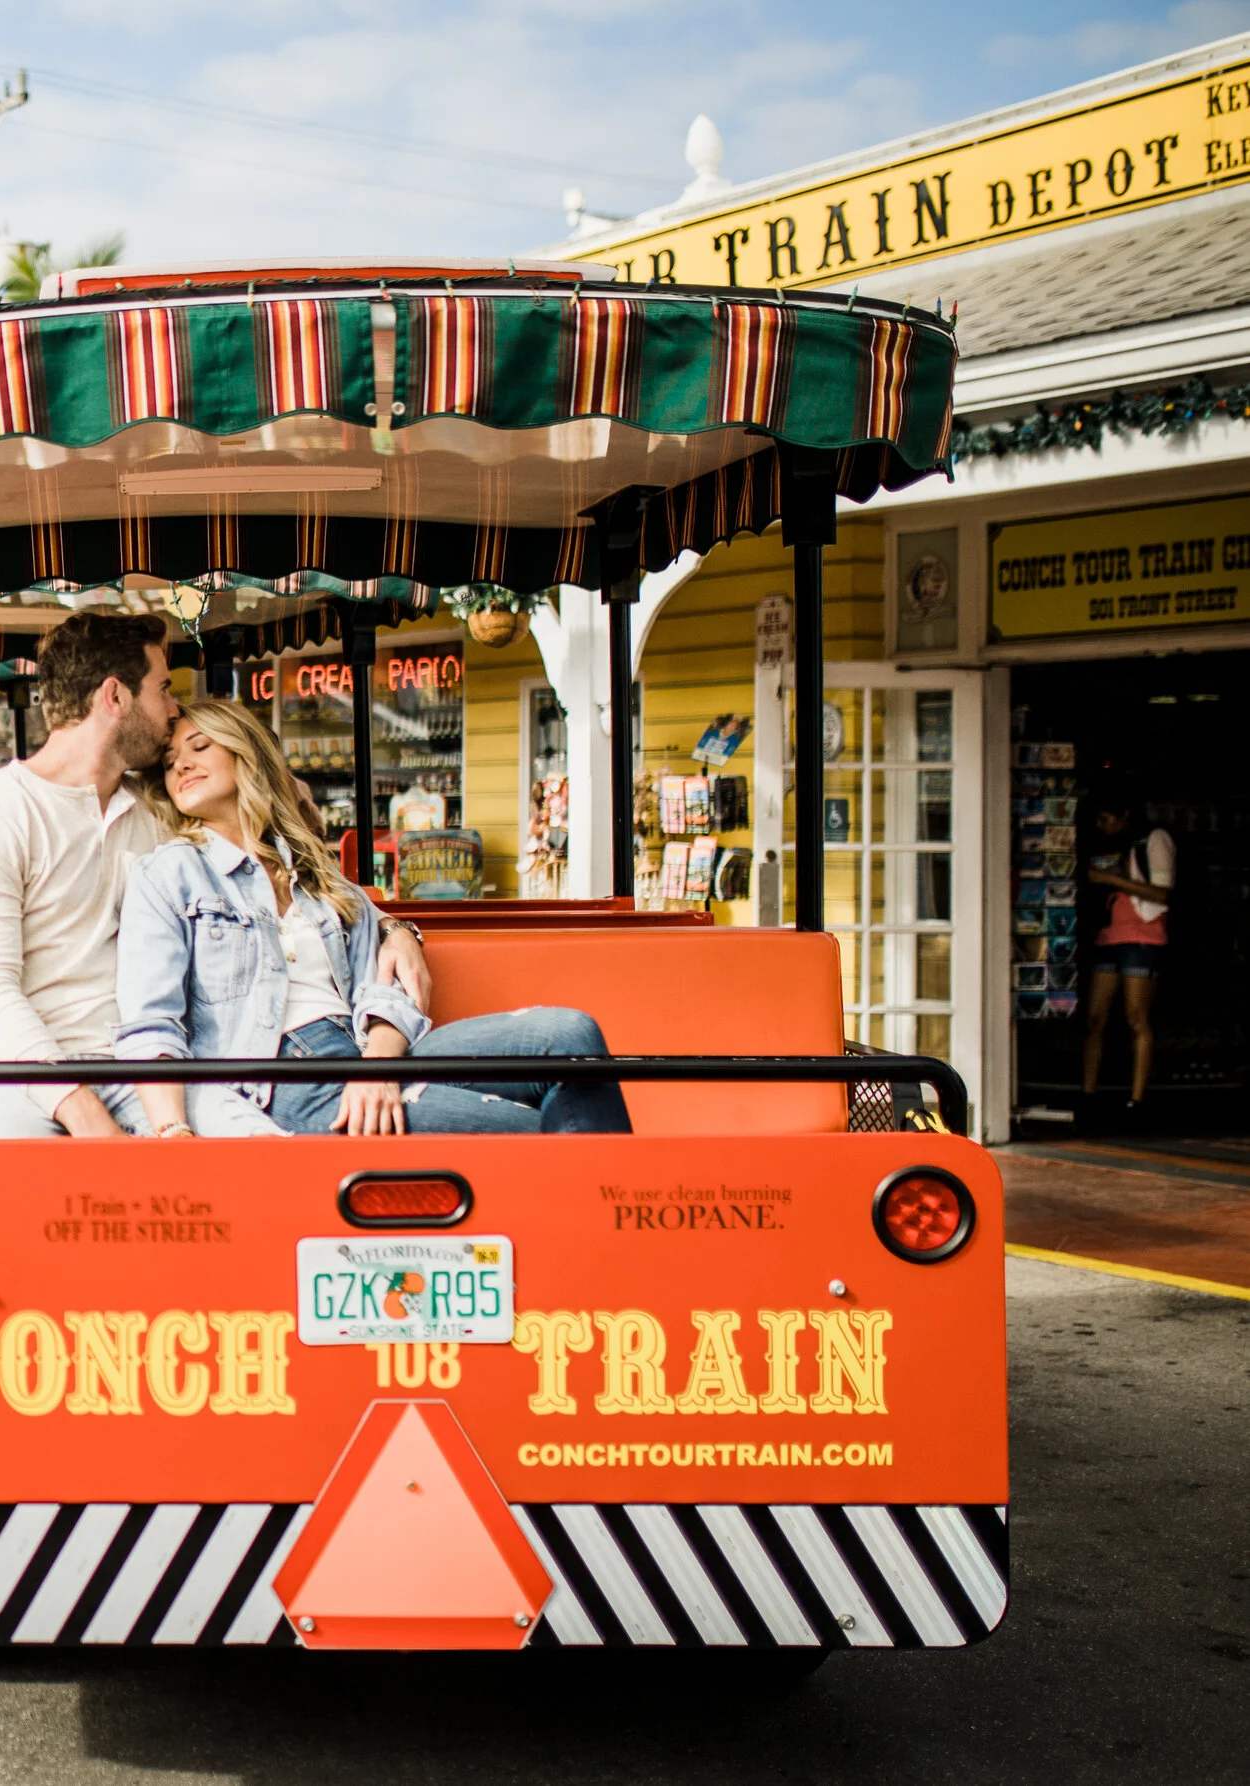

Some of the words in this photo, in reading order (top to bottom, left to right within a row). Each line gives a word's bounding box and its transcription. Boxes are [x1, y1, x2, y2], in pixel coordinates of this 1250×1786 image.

[713, 171, 952, 285] TRAIN
[987, 133, 1180, 228] DEPOT
[998, 553, 1067, 592] CONCH
[1072, 547, 1132, 585] TOUR
[1138, 538, 1215, 579] TRAIN
[1222, 534, 1250, 571] GI
[1175, 586, 1238, 614] STREET
[252, 669, 275, 700] IC
[296, 664, 354, 697] CREA
[79, 1194, 126, 1216] Train
[172, 1194, 212, 1217] Cars
[600, 1185, 627, 1201] We
[634, 1187, 662, 1201] use
[667, 1184, 715, 1202] clean
[721, 1184, 793, 1205] burning
[43, 1220, 83, 1243] OFF
[89, 1219, 131, 1243] THE
[614, 1205, 785, 1231] PROPANE.
[313, 1271, 381, 1320] GZK
[431, 1271, 501, 1319] R95
[350, 1324, 416, 1338] SUNSHINE
[423, 1323, 466, 1338] STATE
[365, 1343, 462, 1389] 108
[512, 1309, 893, 1416] TRAIN
[517, 1443, 893, 1468] CONCHTOURTRAIN.COM
